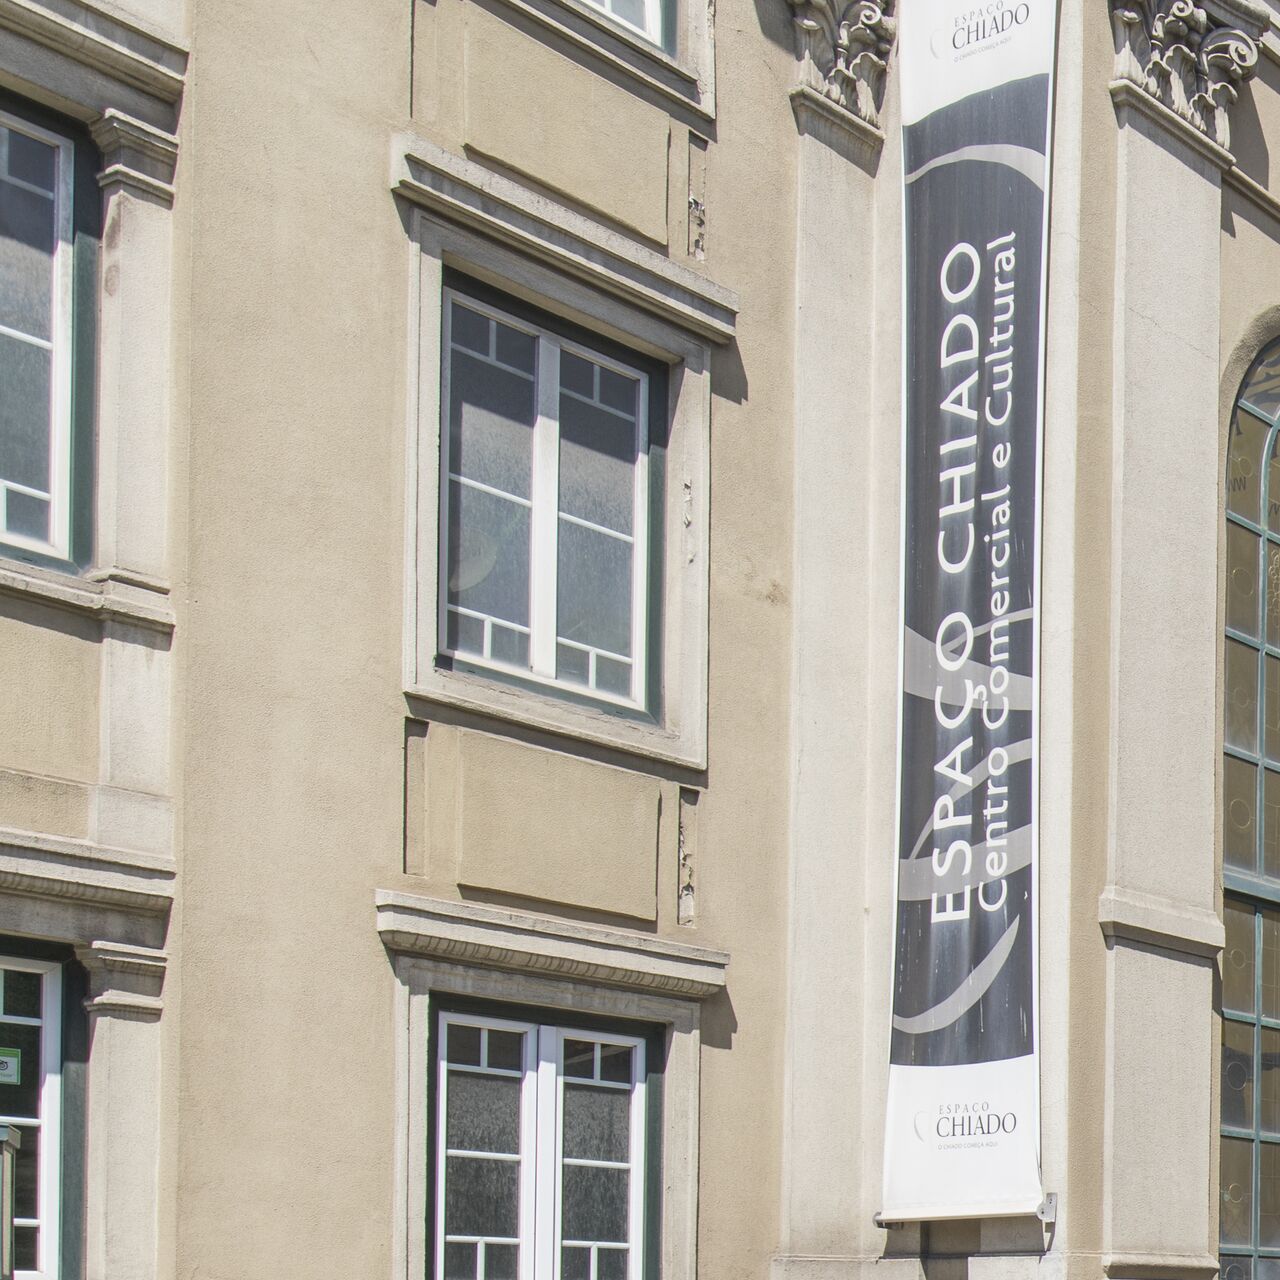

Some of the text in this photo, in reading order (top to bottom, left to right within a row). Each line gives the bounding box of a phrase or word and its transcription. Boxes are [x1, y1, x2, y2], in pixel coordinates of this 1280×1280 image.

[952, 3, 1030, 49] CHIADO
[931, 242, 987, 924] ESPAÇO CHIADO
[978, 231, 1016, 912] Centro Comercial e Cultural
[936, 1112, 1017, 1138] CHIADO
